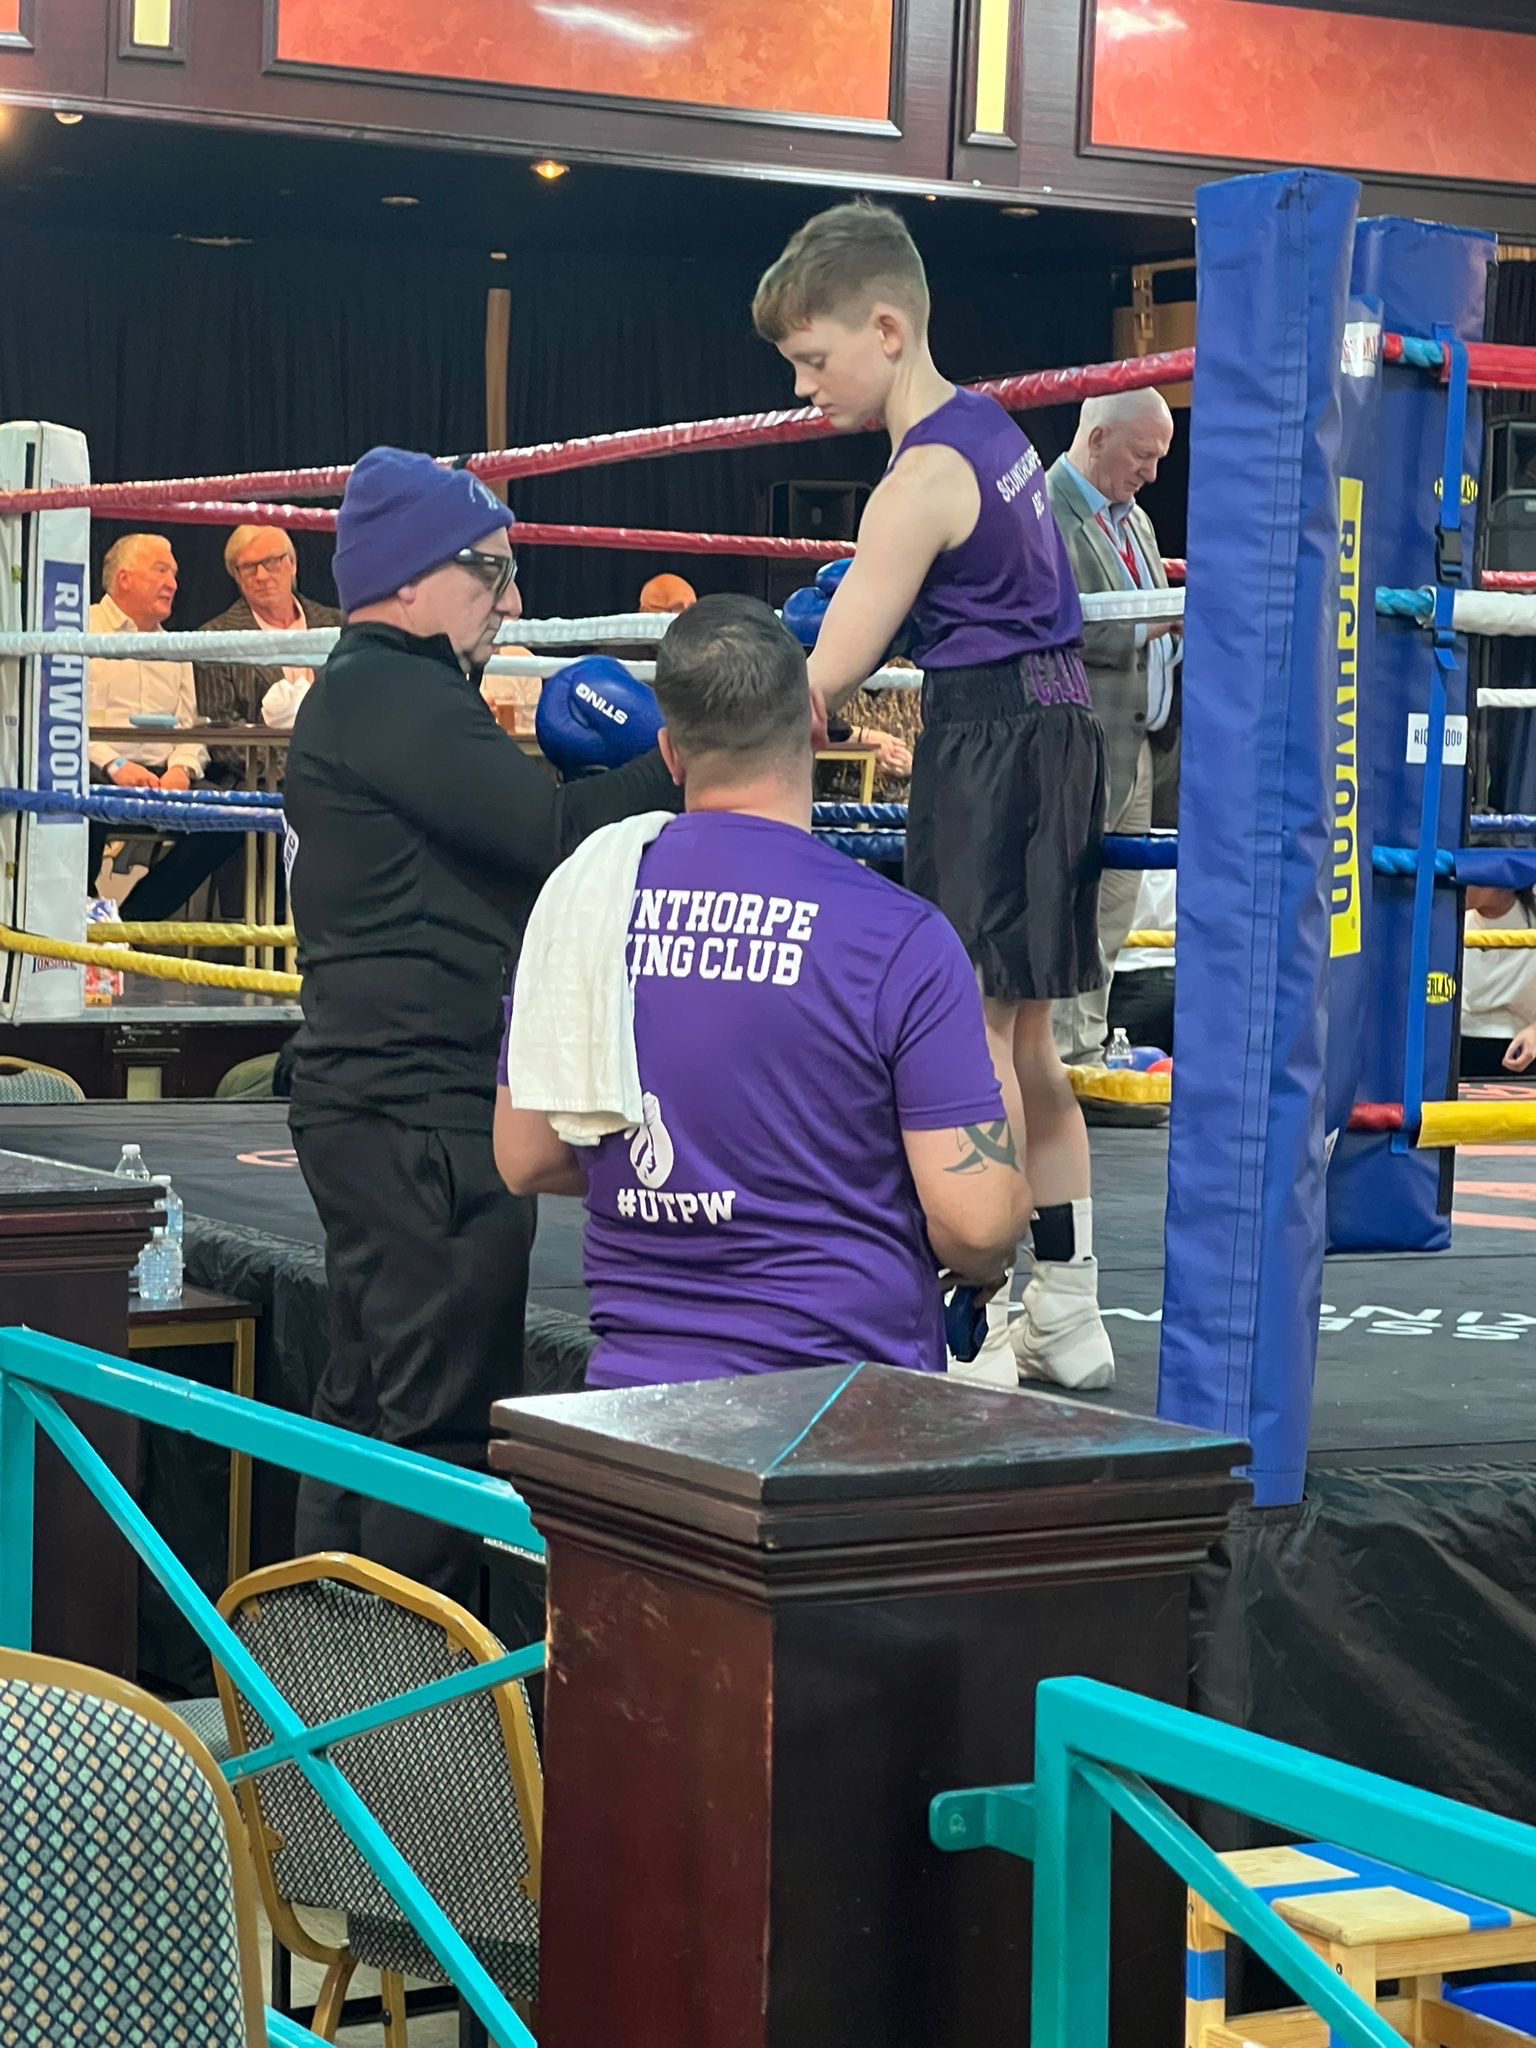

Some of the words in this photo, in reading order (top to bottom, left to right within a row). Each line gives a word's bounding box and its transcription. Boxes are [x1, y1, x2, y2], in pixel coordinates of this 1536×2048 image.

[49, 581, 83, 798] RIHWOOD
[575, 682, 629, 726] STING
[634, 888, 820, 942] NTHORPE
[626, 933, 696, 978] ING
[698, 936, 804, 987] CLUB
[616, 1187, 737, 1225] #UTPW
